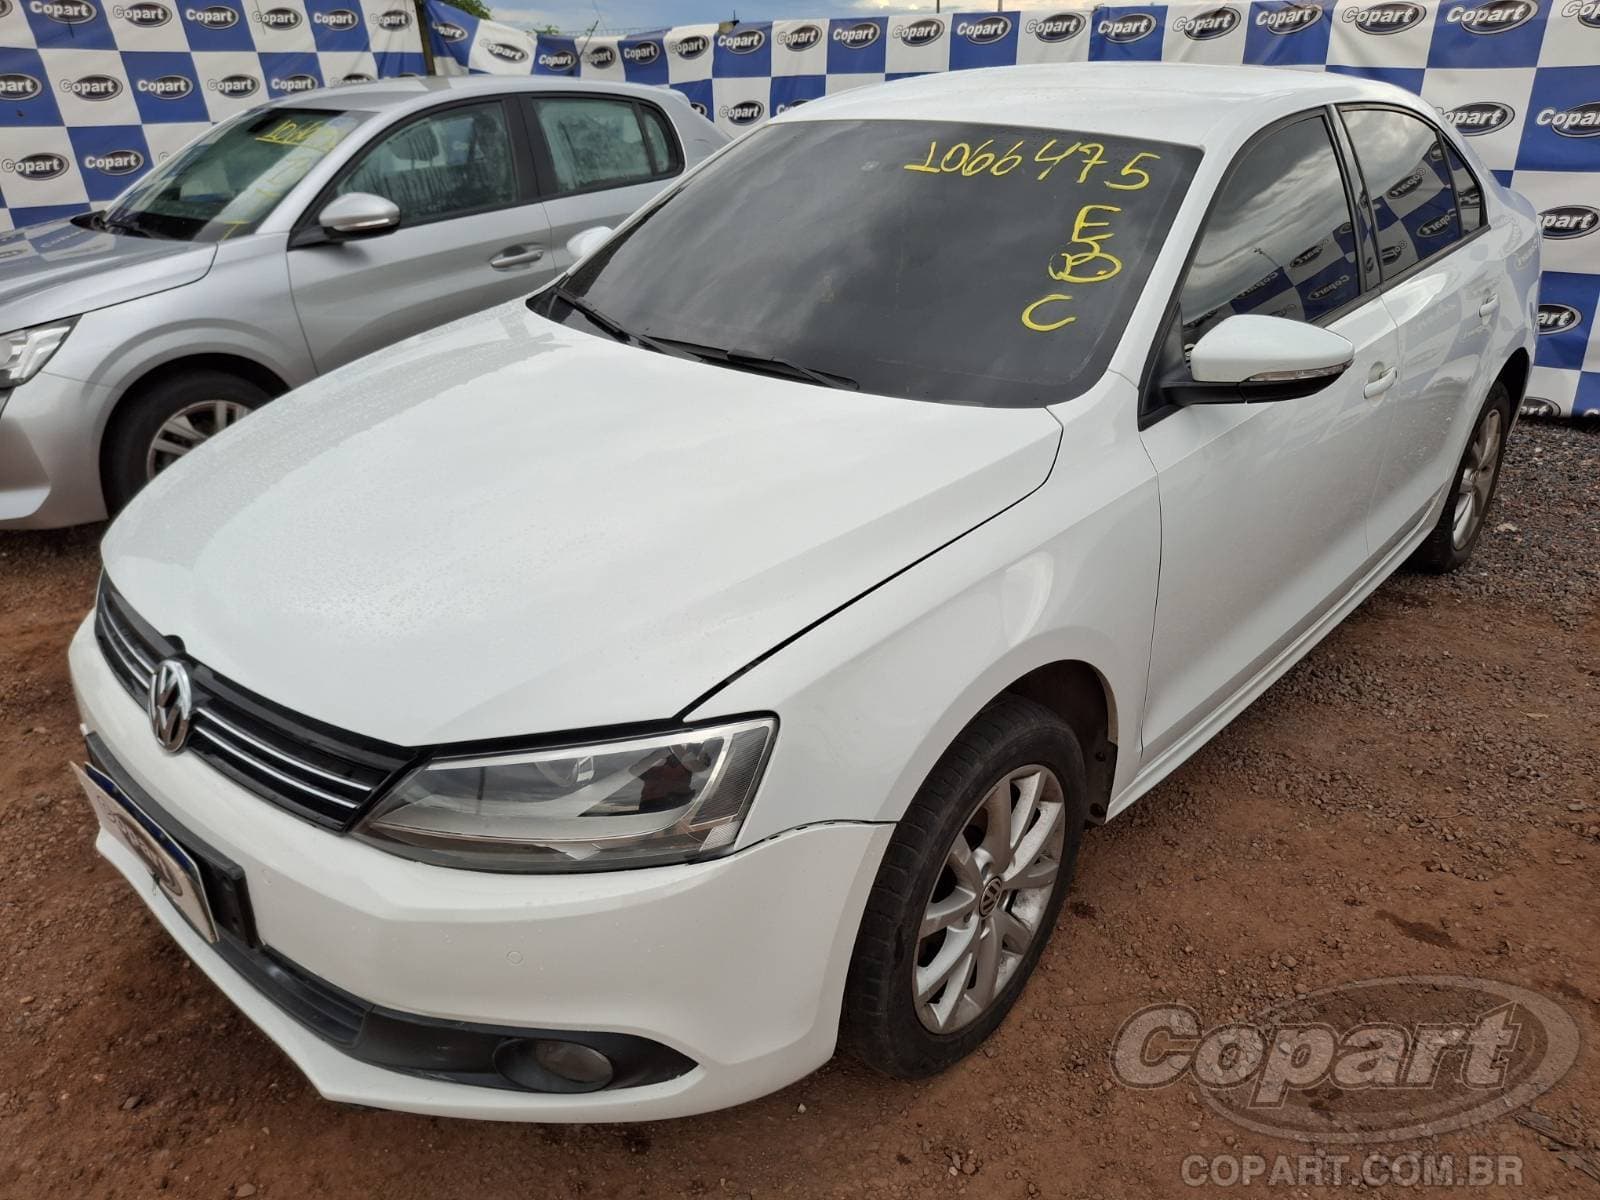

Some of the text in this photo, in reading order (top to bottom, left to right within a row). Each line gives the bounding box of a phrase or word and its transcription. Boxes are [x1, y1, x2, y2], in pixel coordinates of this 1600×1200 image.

[30, 1, 89, 17] Copart
[112, 6, 164, 21] Copart
[185, 9, 233, 22] Copart
[1342, 7, 1415, 26] Copart
[1446, 4, 1526, 26] Copart
[253, 11, 296, 25] Copart
[314, 13, 353, 26] Copart
[370, 14, 407, 26] Copart
[1172, 14, 1234, 32] Copart
[1255, 8, 1313, 27] Copart
[832, 26, 875, 42] Copart
[893, 24, 938, 41] Copart
[956, 20, 1004, 39] Copart
[1025, 18, 1078, 36] Copart
[717, 33, 760, 50] Copart
[777, 29, 816, 46] Copart
[480, 39, 523, 60] Copart
[624, 45, 655, 60] Copart
[669, 38, 704, 55] Copart
[538, 54, 572, 69] Copart
[60, 79, 114, 95] Copart
[137, 79, 187, 94] Copart
[207, 79, 253, 93] Copart
[271, 78, 313, 91] Copart
[719, 105, 760, 123] Copart
[2, 158, 60, 174] Copart
[84, 154, 138, 169] Copart
[1071, 204, 1121, 243] E
[1021, 293, 1076, 332] C
